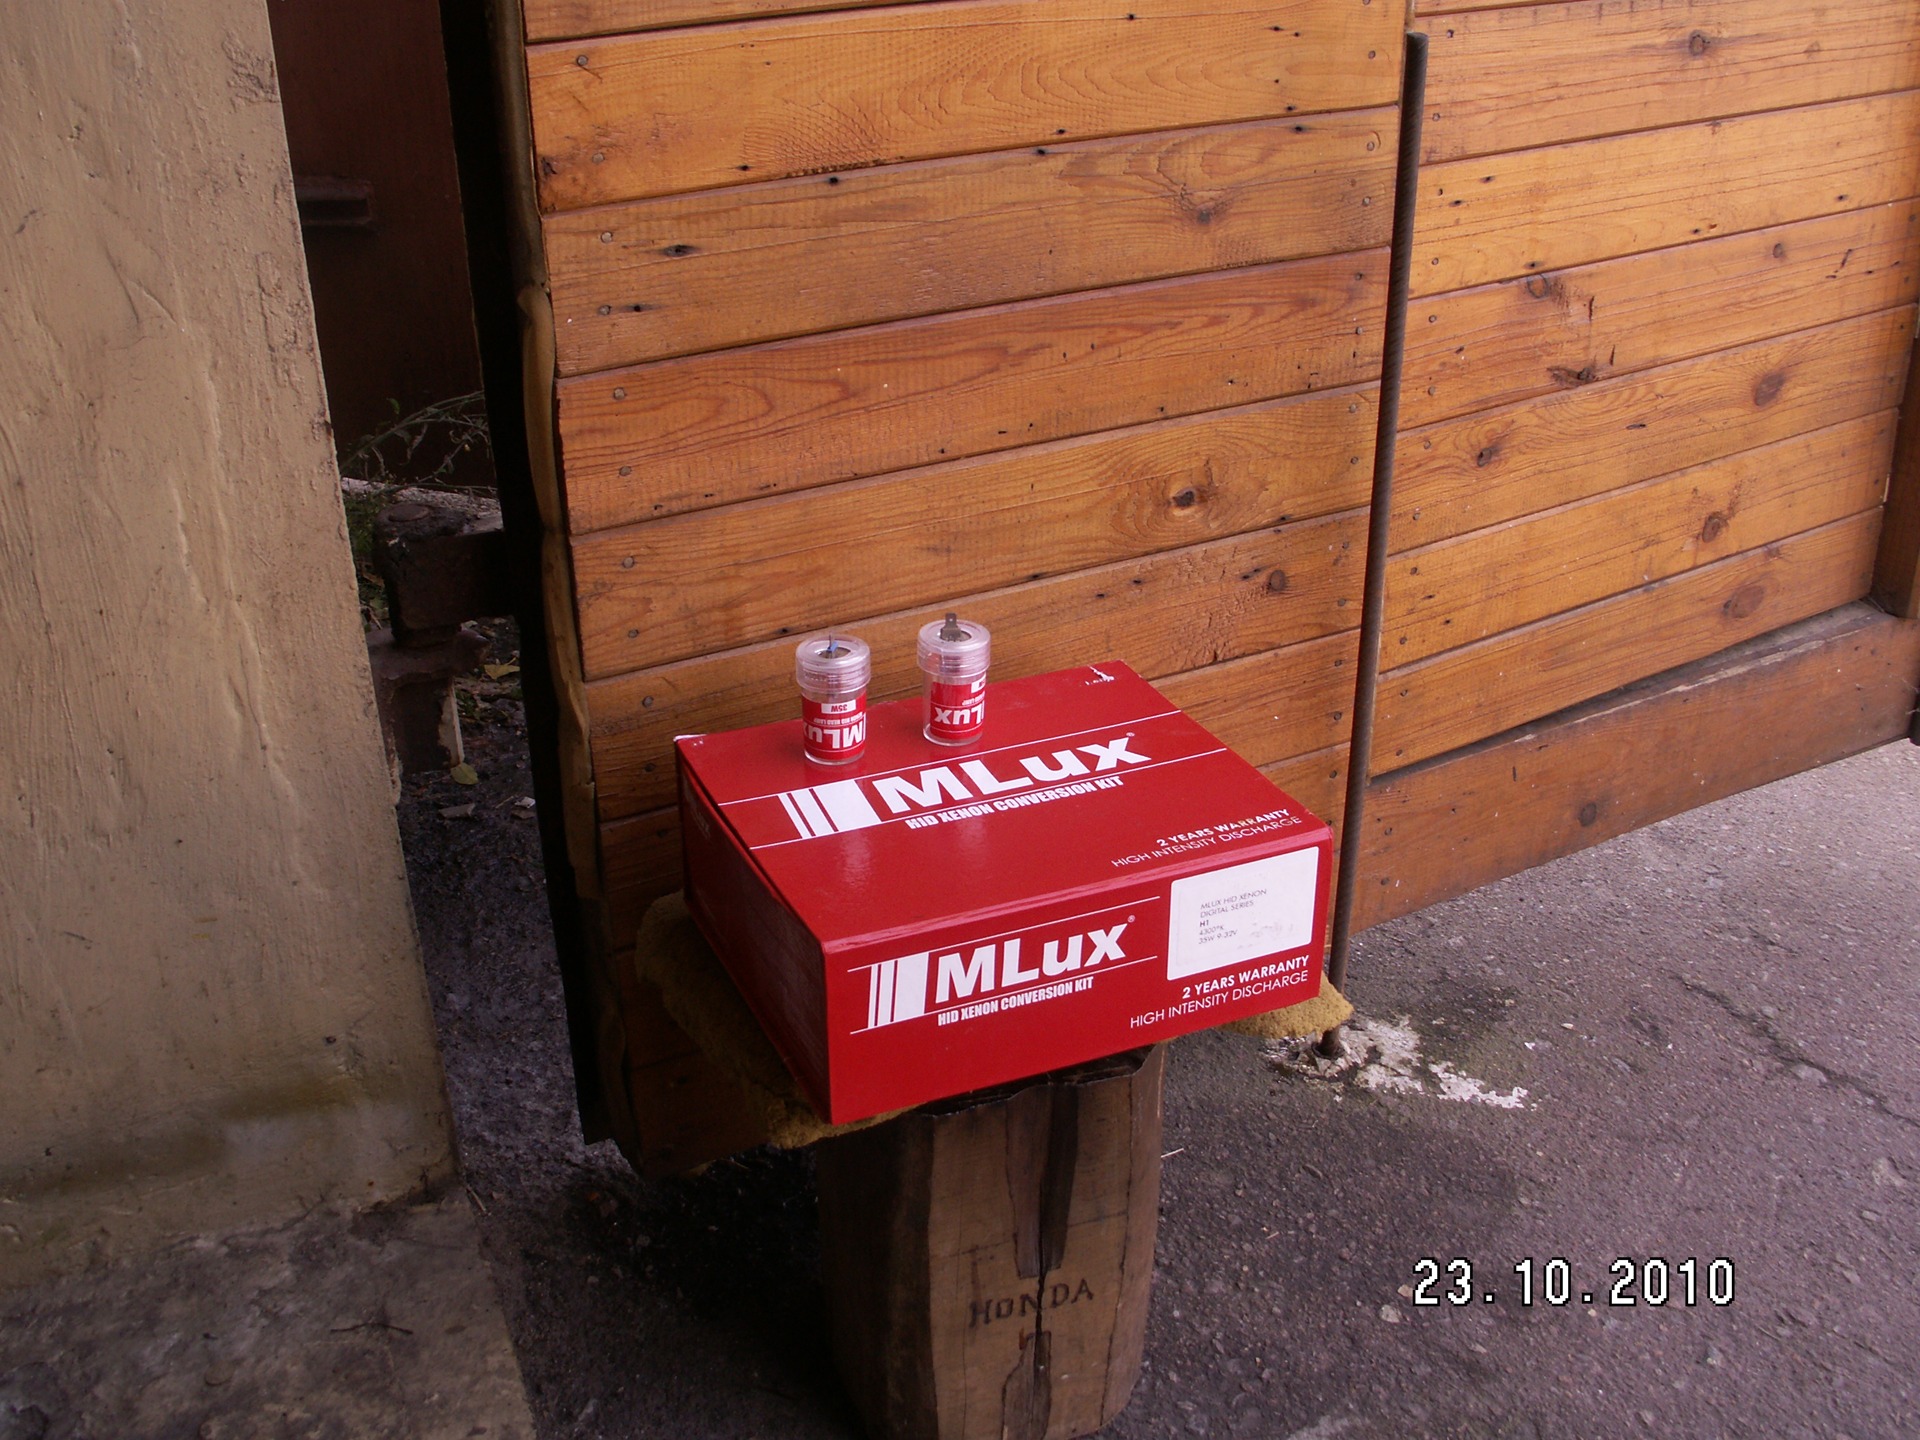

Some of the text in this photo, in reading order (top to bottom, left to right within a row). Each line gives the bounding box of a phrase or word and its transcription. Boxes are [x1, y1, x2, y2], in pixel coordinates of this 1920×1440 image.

[830, 704, 848, 713] 35W
[905, 775, 1124, 829] HID XENON CONVERSION KIT
[1111, 816, 1303, 868] HIGH INTENSITY DISCHARGE
[1156, 808, 1290, 847] 2 YEARS WARRANTY
[1200, 901, 1254, 918] DIGITAL SERIES
[1201, 889, 1267, 909] MLUX HID XENON
[1199, 919, 1210, 928] H1
[1199, 936, 1214, 944] 35W
[1181, 955, 1310, 999] 2 YEARS WARRANTY
[937, 976, 1094, 1026] HID XENON CONVERSION KIT
[1130, 970, 1309, 1028] HIGH INTENSITY DISCHARGE
[969, 1278, 1094, 1329] HONDA
